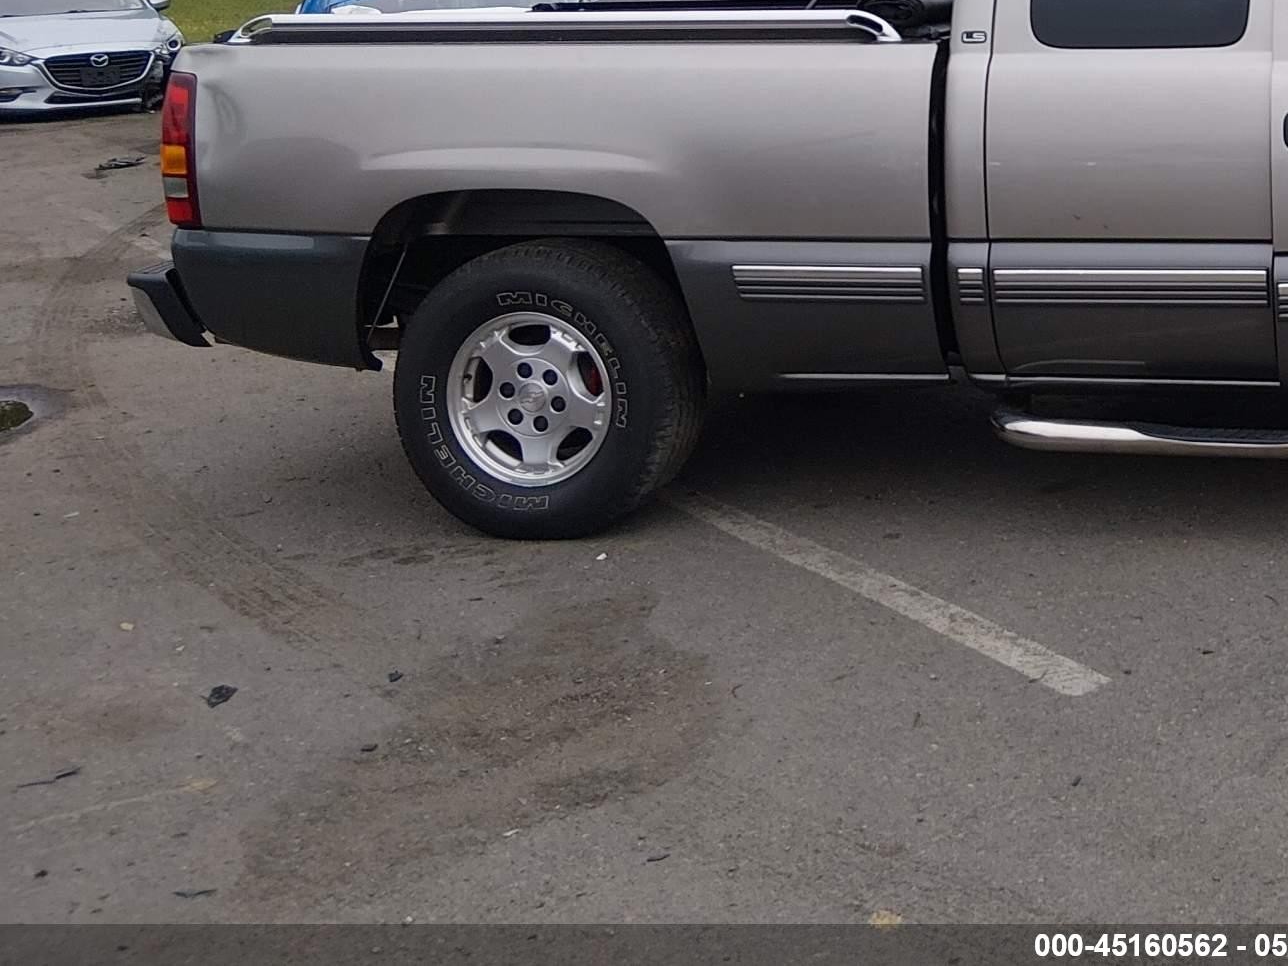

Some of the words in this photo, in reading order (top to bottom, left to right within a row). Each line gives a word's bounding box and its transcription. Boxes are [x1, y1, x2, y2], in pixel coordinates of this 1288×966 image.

[962, 31, 986, 42] LS
[496, 291, 628, 428] MICHELIN
[420, 375, 549, 510] MICHELIN
